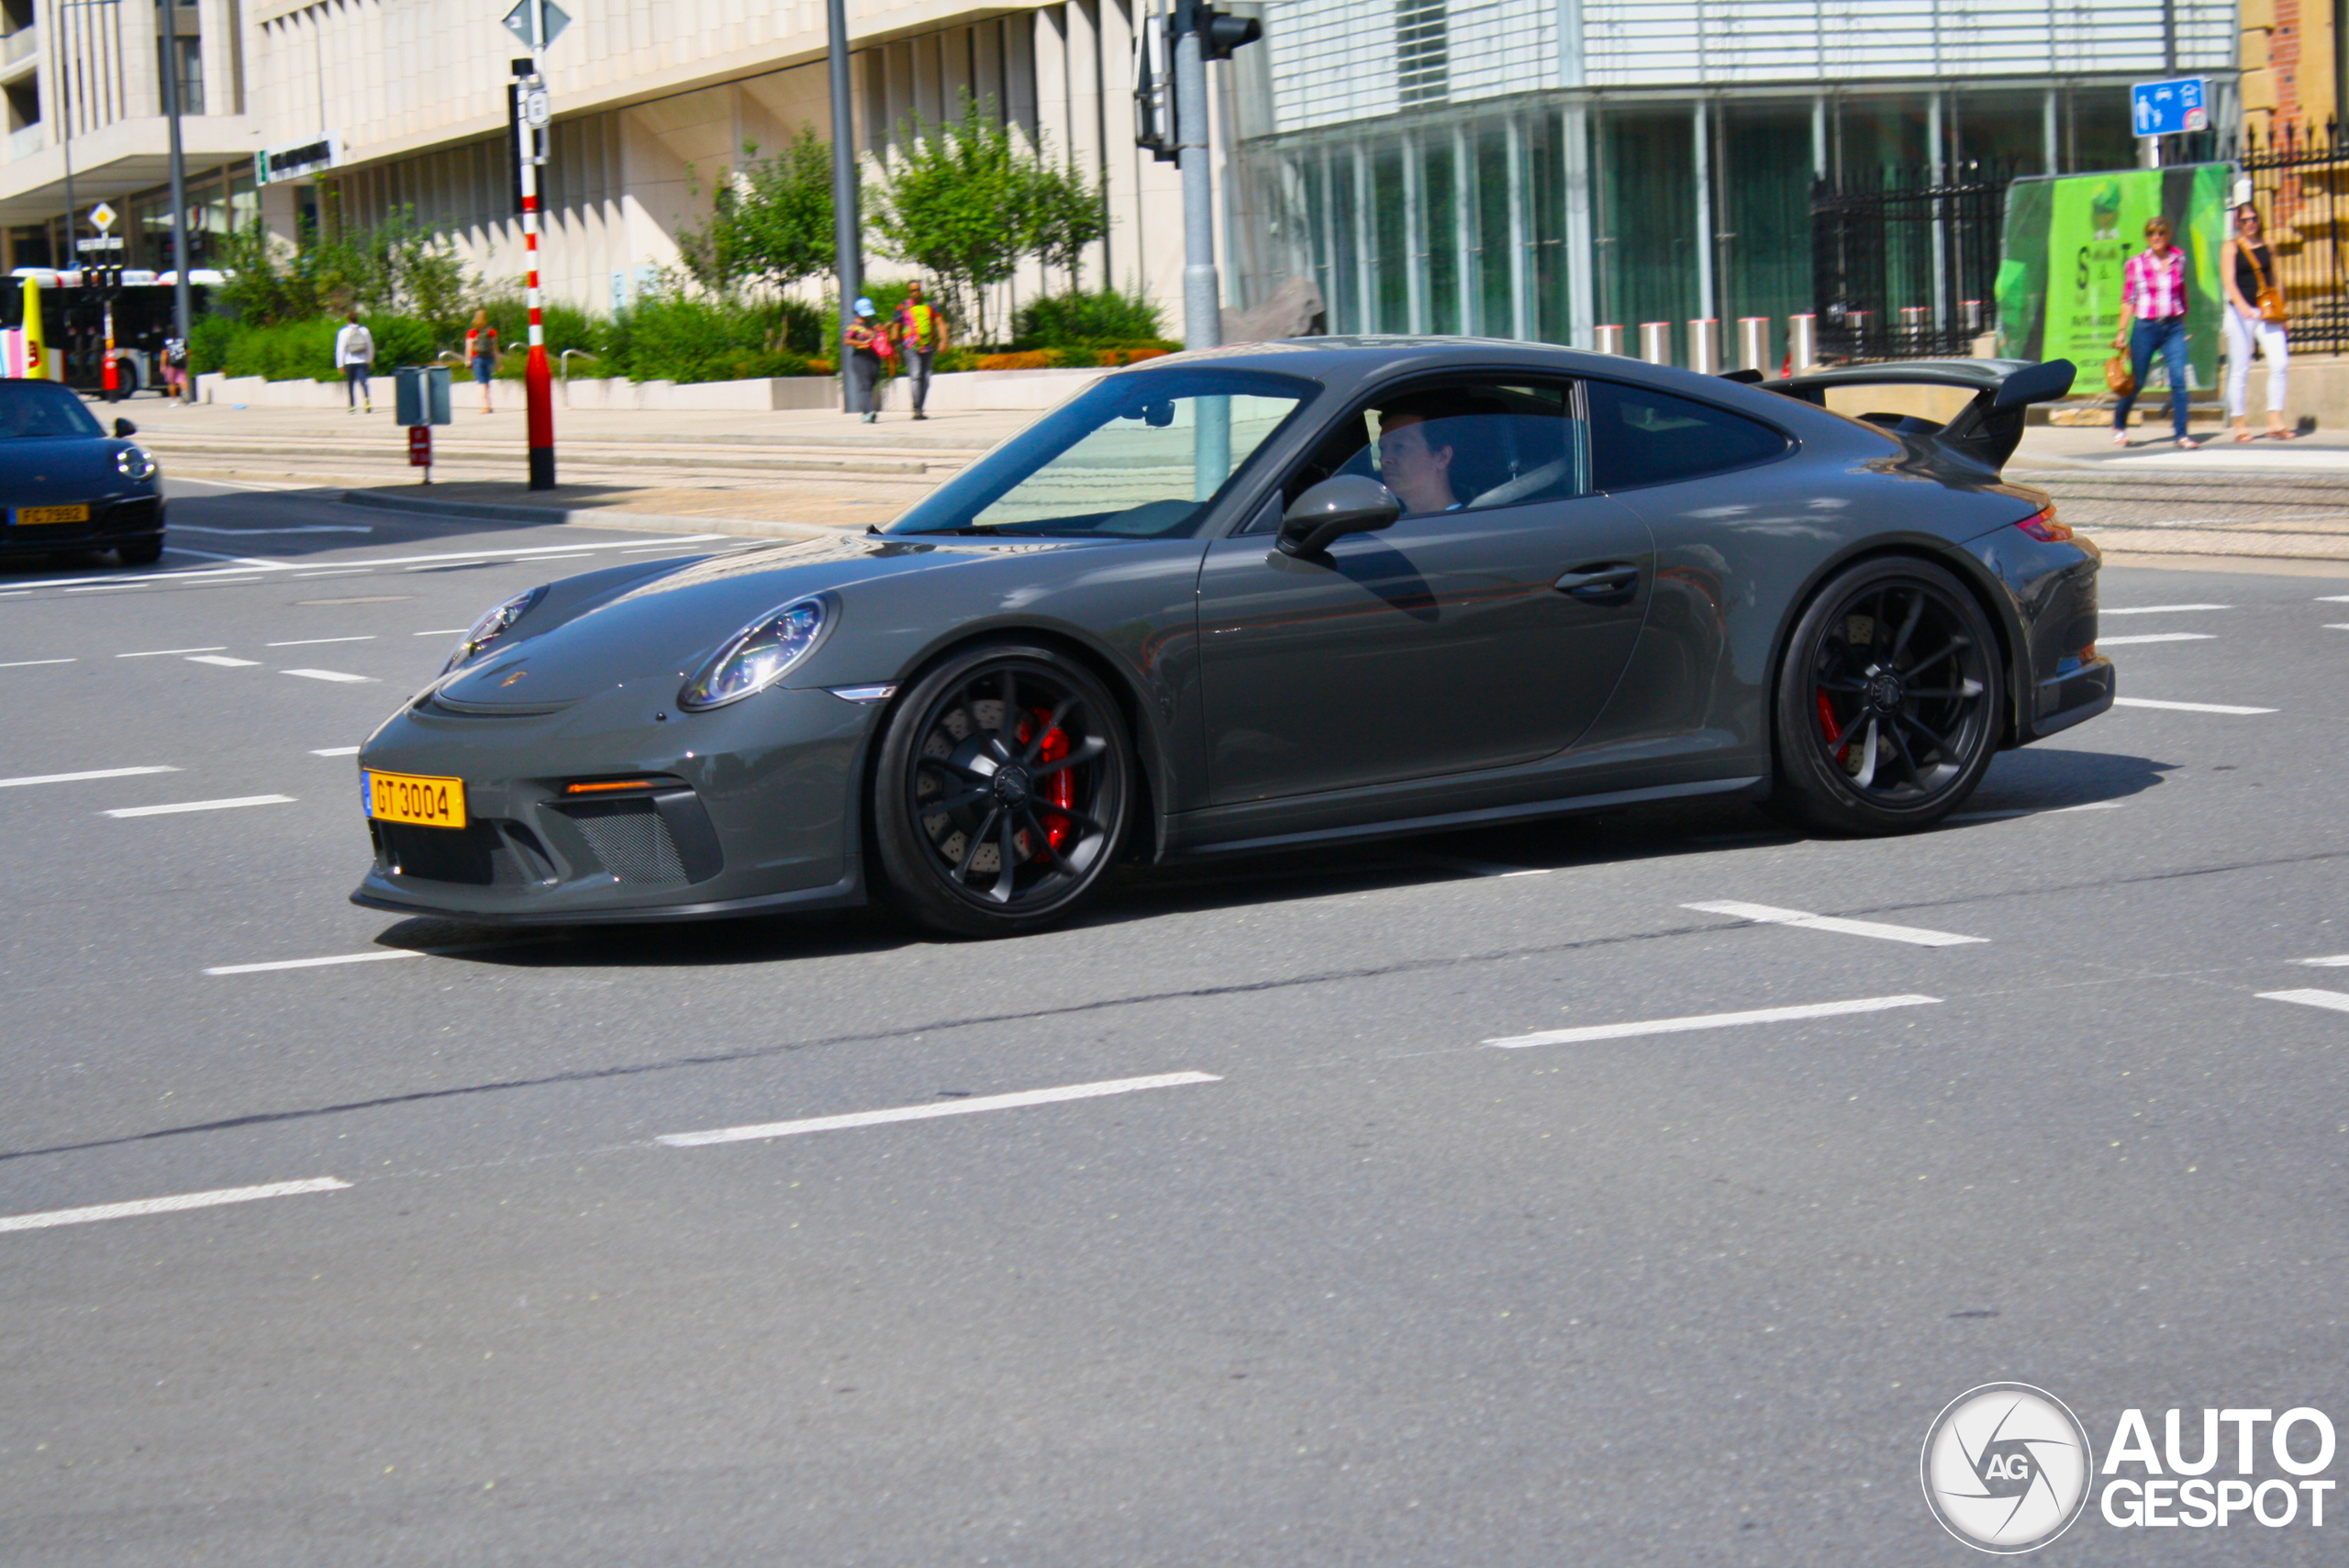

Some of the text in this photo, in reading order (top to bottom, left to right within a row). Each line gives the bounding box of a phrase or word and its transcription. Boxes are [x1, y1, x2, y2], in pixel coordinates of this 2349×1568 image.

[23, 507, 82, 522] FC 7992
[377, 779, 449, 820] GT 3004
